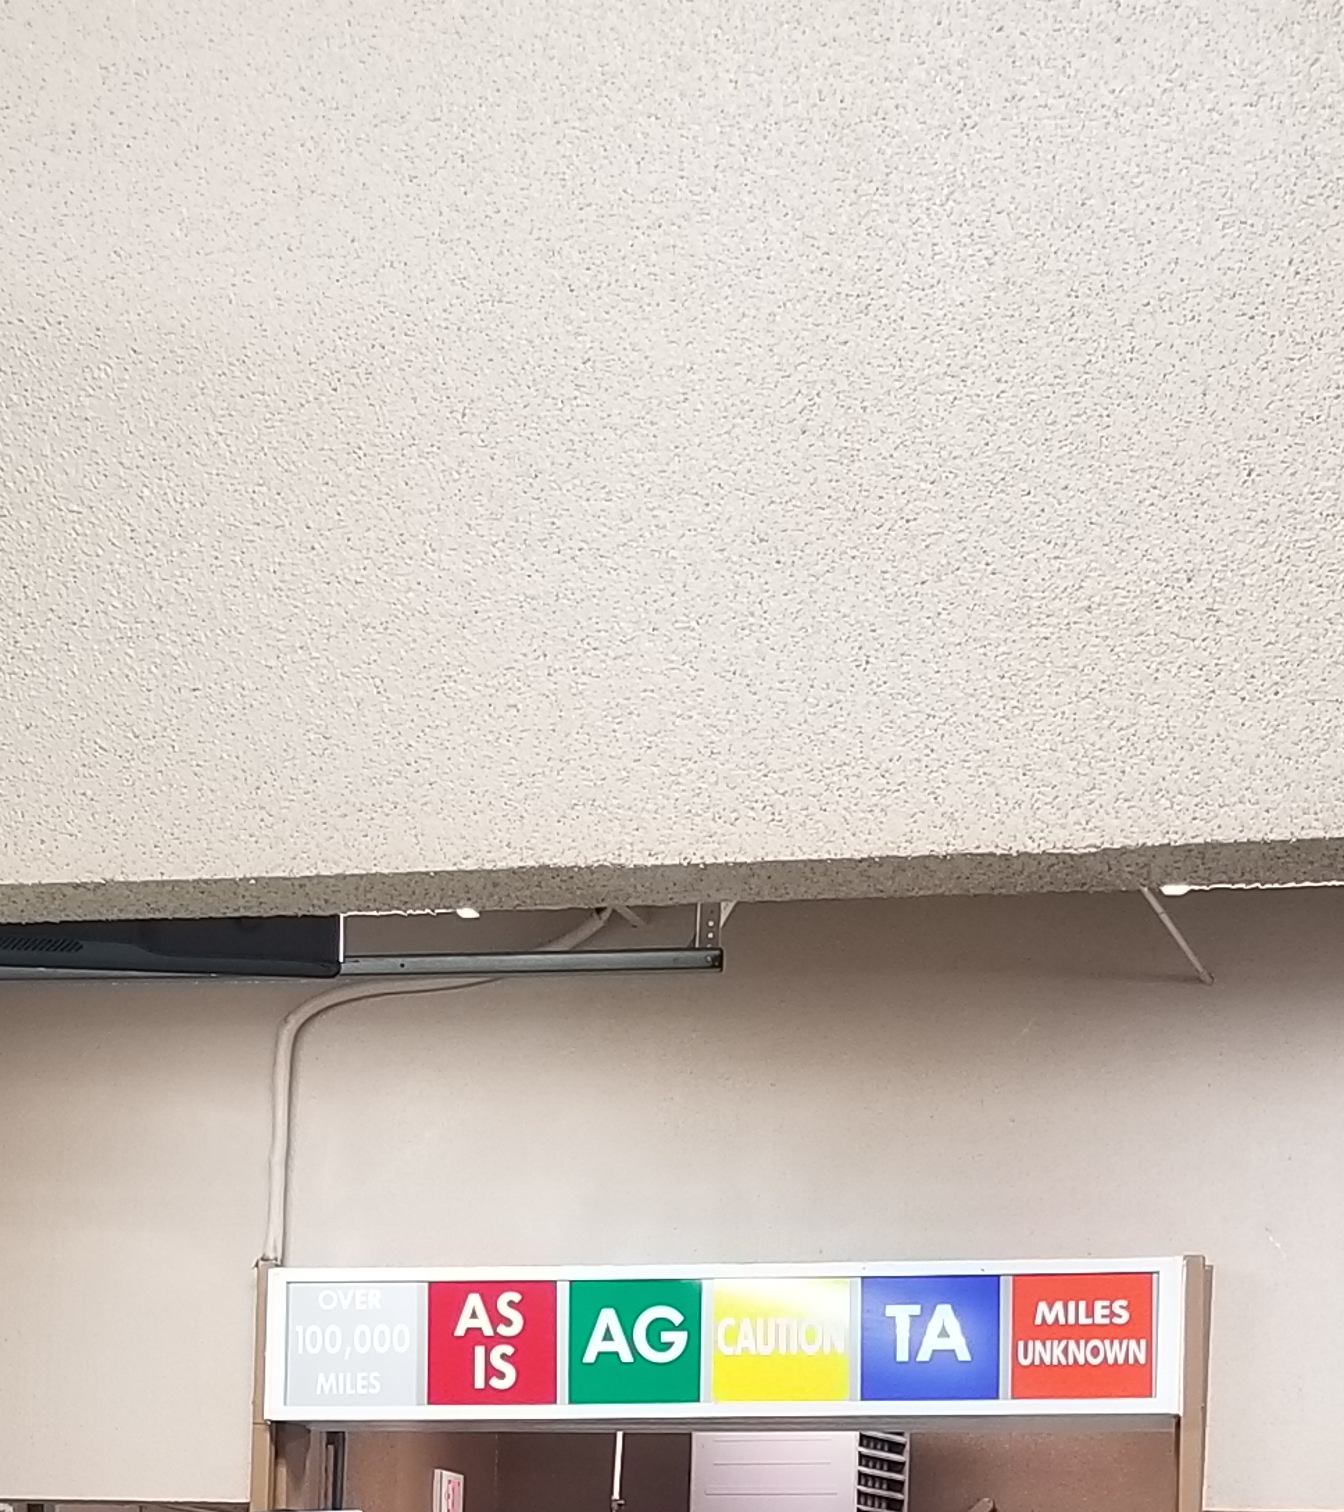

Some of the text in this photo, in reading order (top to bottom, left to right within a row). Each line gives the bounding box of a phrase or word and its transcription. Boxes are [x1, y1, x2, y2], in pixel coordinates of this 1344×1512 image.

[317, 1289, 382, 1310] OVER
[453, 1291, 525, 1337] AS
[1034, 1299, 1130, 1327] MILES
[295, 1324, 411, 1360] 100,000
[582, 1305, 689, 1364] AG
[717, 1317, 845, 1356] CAUTION
[885, 1304, 972, 1362] TA
[473, 1345, 517, 1390] IS
[1017, 1339, 1146, 1367] UNKNOWN
[316, 1372, 381, 1396] MILES
